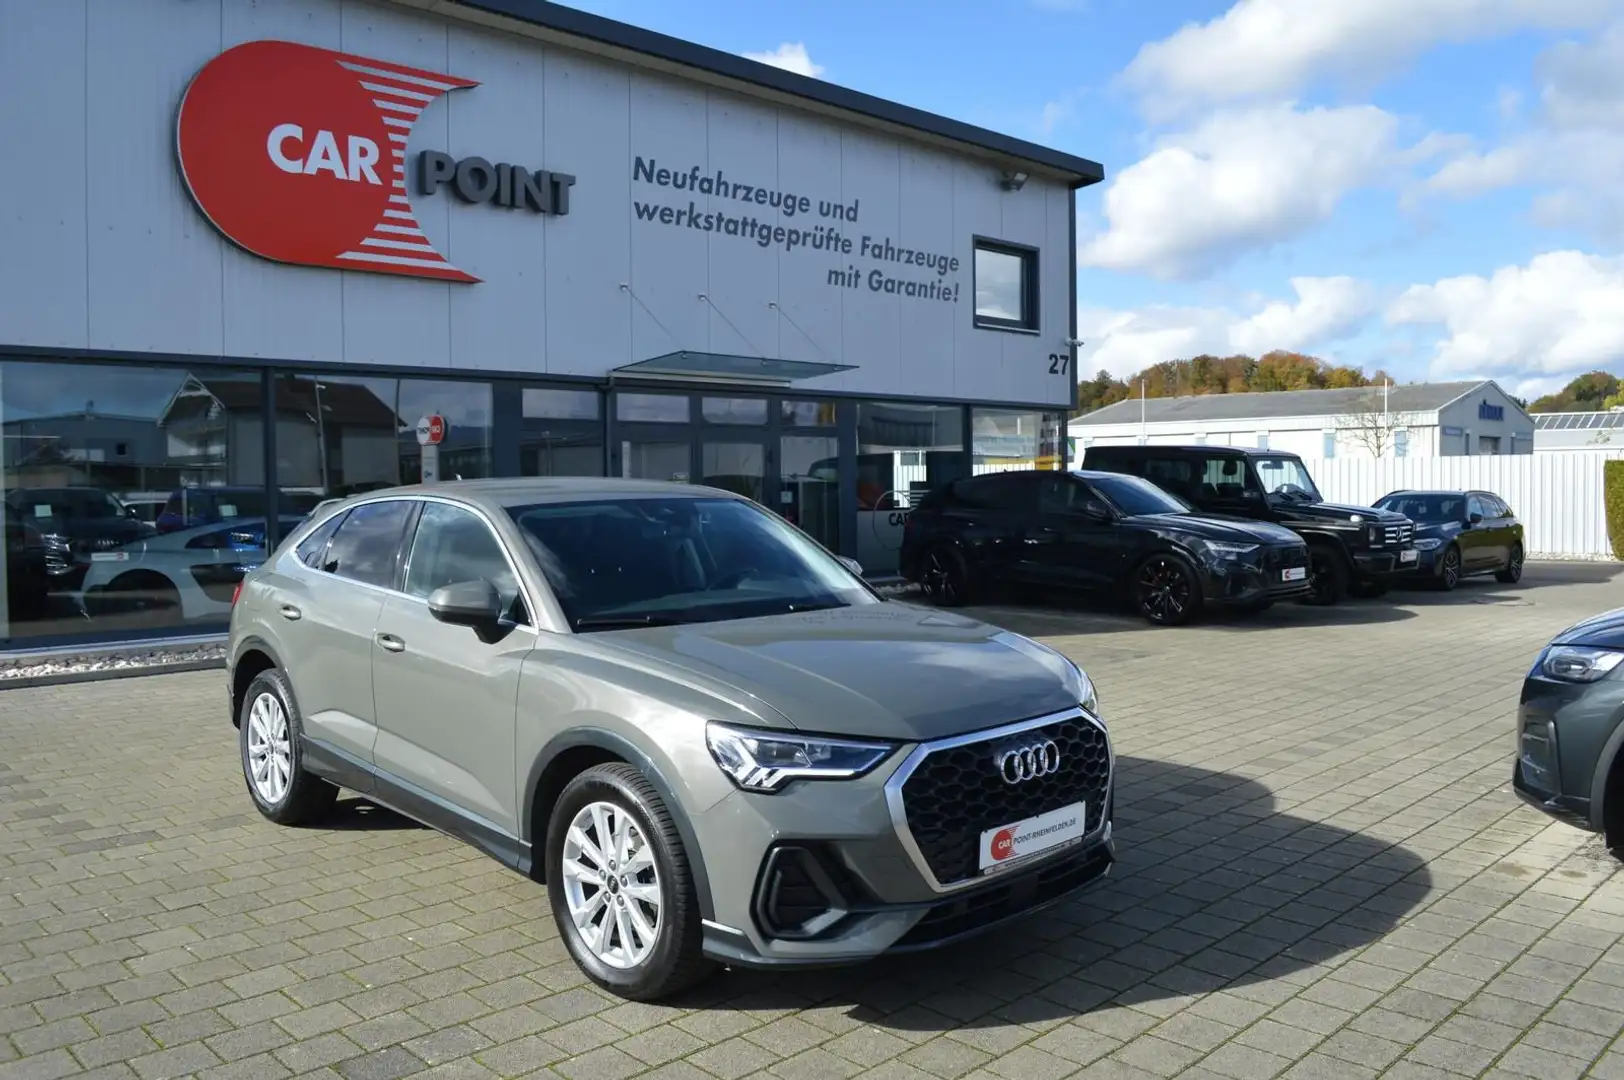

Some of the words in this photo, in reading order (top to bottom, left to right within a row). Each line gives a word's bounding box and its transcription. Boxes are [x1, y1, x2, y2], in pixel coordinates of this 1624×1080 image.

[266, 123, 383, 186] CAR
[420, 149, 576, 215] POINT
[633, 156, 811, 214] Neufahrzeuge
[818, 199, 859, 222] und
[634, 201, 852, 251] werkstattgeprüfte
[860, 235, 960, 276] Fahrzeuge
[827, 265, 860, 289] mit
[868, 269, 960, 303] Garantie!
[1048, 353, 1070, 376] 27
